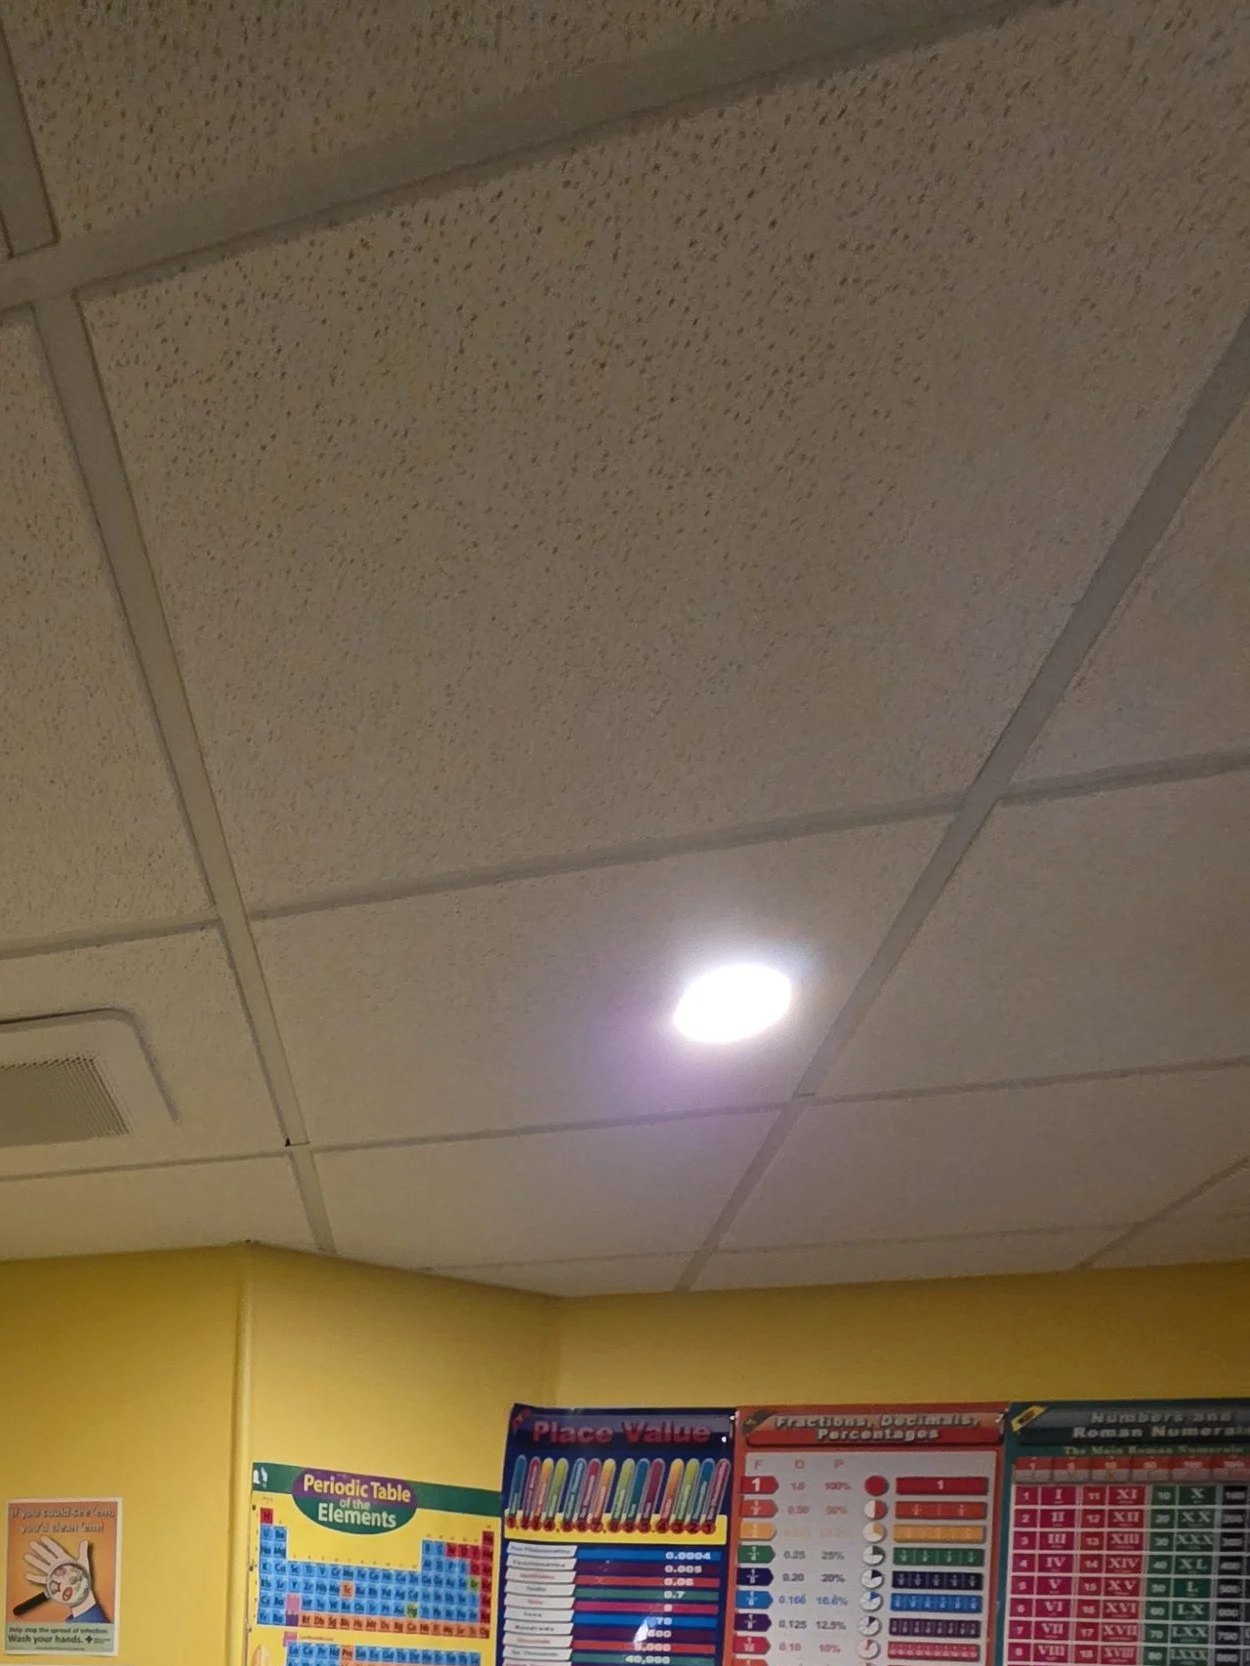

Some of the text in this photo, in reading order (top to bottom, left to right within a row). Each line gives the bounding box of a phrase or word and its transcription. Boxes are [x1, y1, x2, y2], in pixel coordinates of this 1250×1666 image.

[775, 1415, 979, 1427] Fractions, Decimals,
[1091, 1412, 1185, 1423] Numbers
[533, 1420, 711, 1444] Place Value
[817, 1428, 939, 1441] Percentages
[1072, 1427, 1143, 1438] Roman
[754, 1460, 762, 1469] F
[834, 1460, 843, 1468] P
[303, 1474, 411, 1503] Periodic Table
[752, 1479, 760, 1491] 1
[937, 1480, 944, 1489] 1
[1117, 1489, 1137, 1499] XI
[1191, 1488, 1204, 1499] X
[340, 1499, 370, 1510] of the
[318, 1503, 397, 1528] Elements
[1052, 1512, 1065, 1522] II
[1113, 1512, 1139, 1522] XII
[1021, 1537, 1028, 1545] 3
[1048, 1534, 1065, 1544] III
[1111, 1534, 1139, 1544] XIII
[1177, 1534, 1213, 1544] XXX
[665, 1552, 711, 1560] 0.0004
[784, 1551, 805, 1560] 0.25
[821, 1551, 844, 1559] 25%
[1046, 1557, 1064, 1567] IV
[1109, 1558, 1138, 1568] XIV
[665, 1565, 702, 1574] 0.005
[782, 1574, 804, 1582] 0.20
[821, 1574, 845, 1582] 20%
[1049, 1580, 1062, 1589] V
[1187, 1582, 1198, 1592] L
[664, 1591, 685, 1599] 0.7
[1045, 1602, 1063, 1612] VI
[1106, 1603, 1136, 1613] XVI
[1178, 1605, 1204, 1615] LX
[779, 1620, 807, 1629] 0.125
[816, 1621, 846, 1630] 12.5%
[1042, 1624, 1063, 1634] VII
[1017, 1627, 1023, 1635] 7
[1104, 1625, 1137, 1635] XVII
[1173, 1627, 1207, 1637] LXX
[33, 1636, 52, 1644] your
[55, 1635, 83, 1643] hands.
[1038, 1646, 1064, 1655] VIII
[1104, 1648, 1134, 1658] XVIII
[1170, 1650, 1206, 1660] LXXX
[625, 1656, 670, 1665] 40,000
